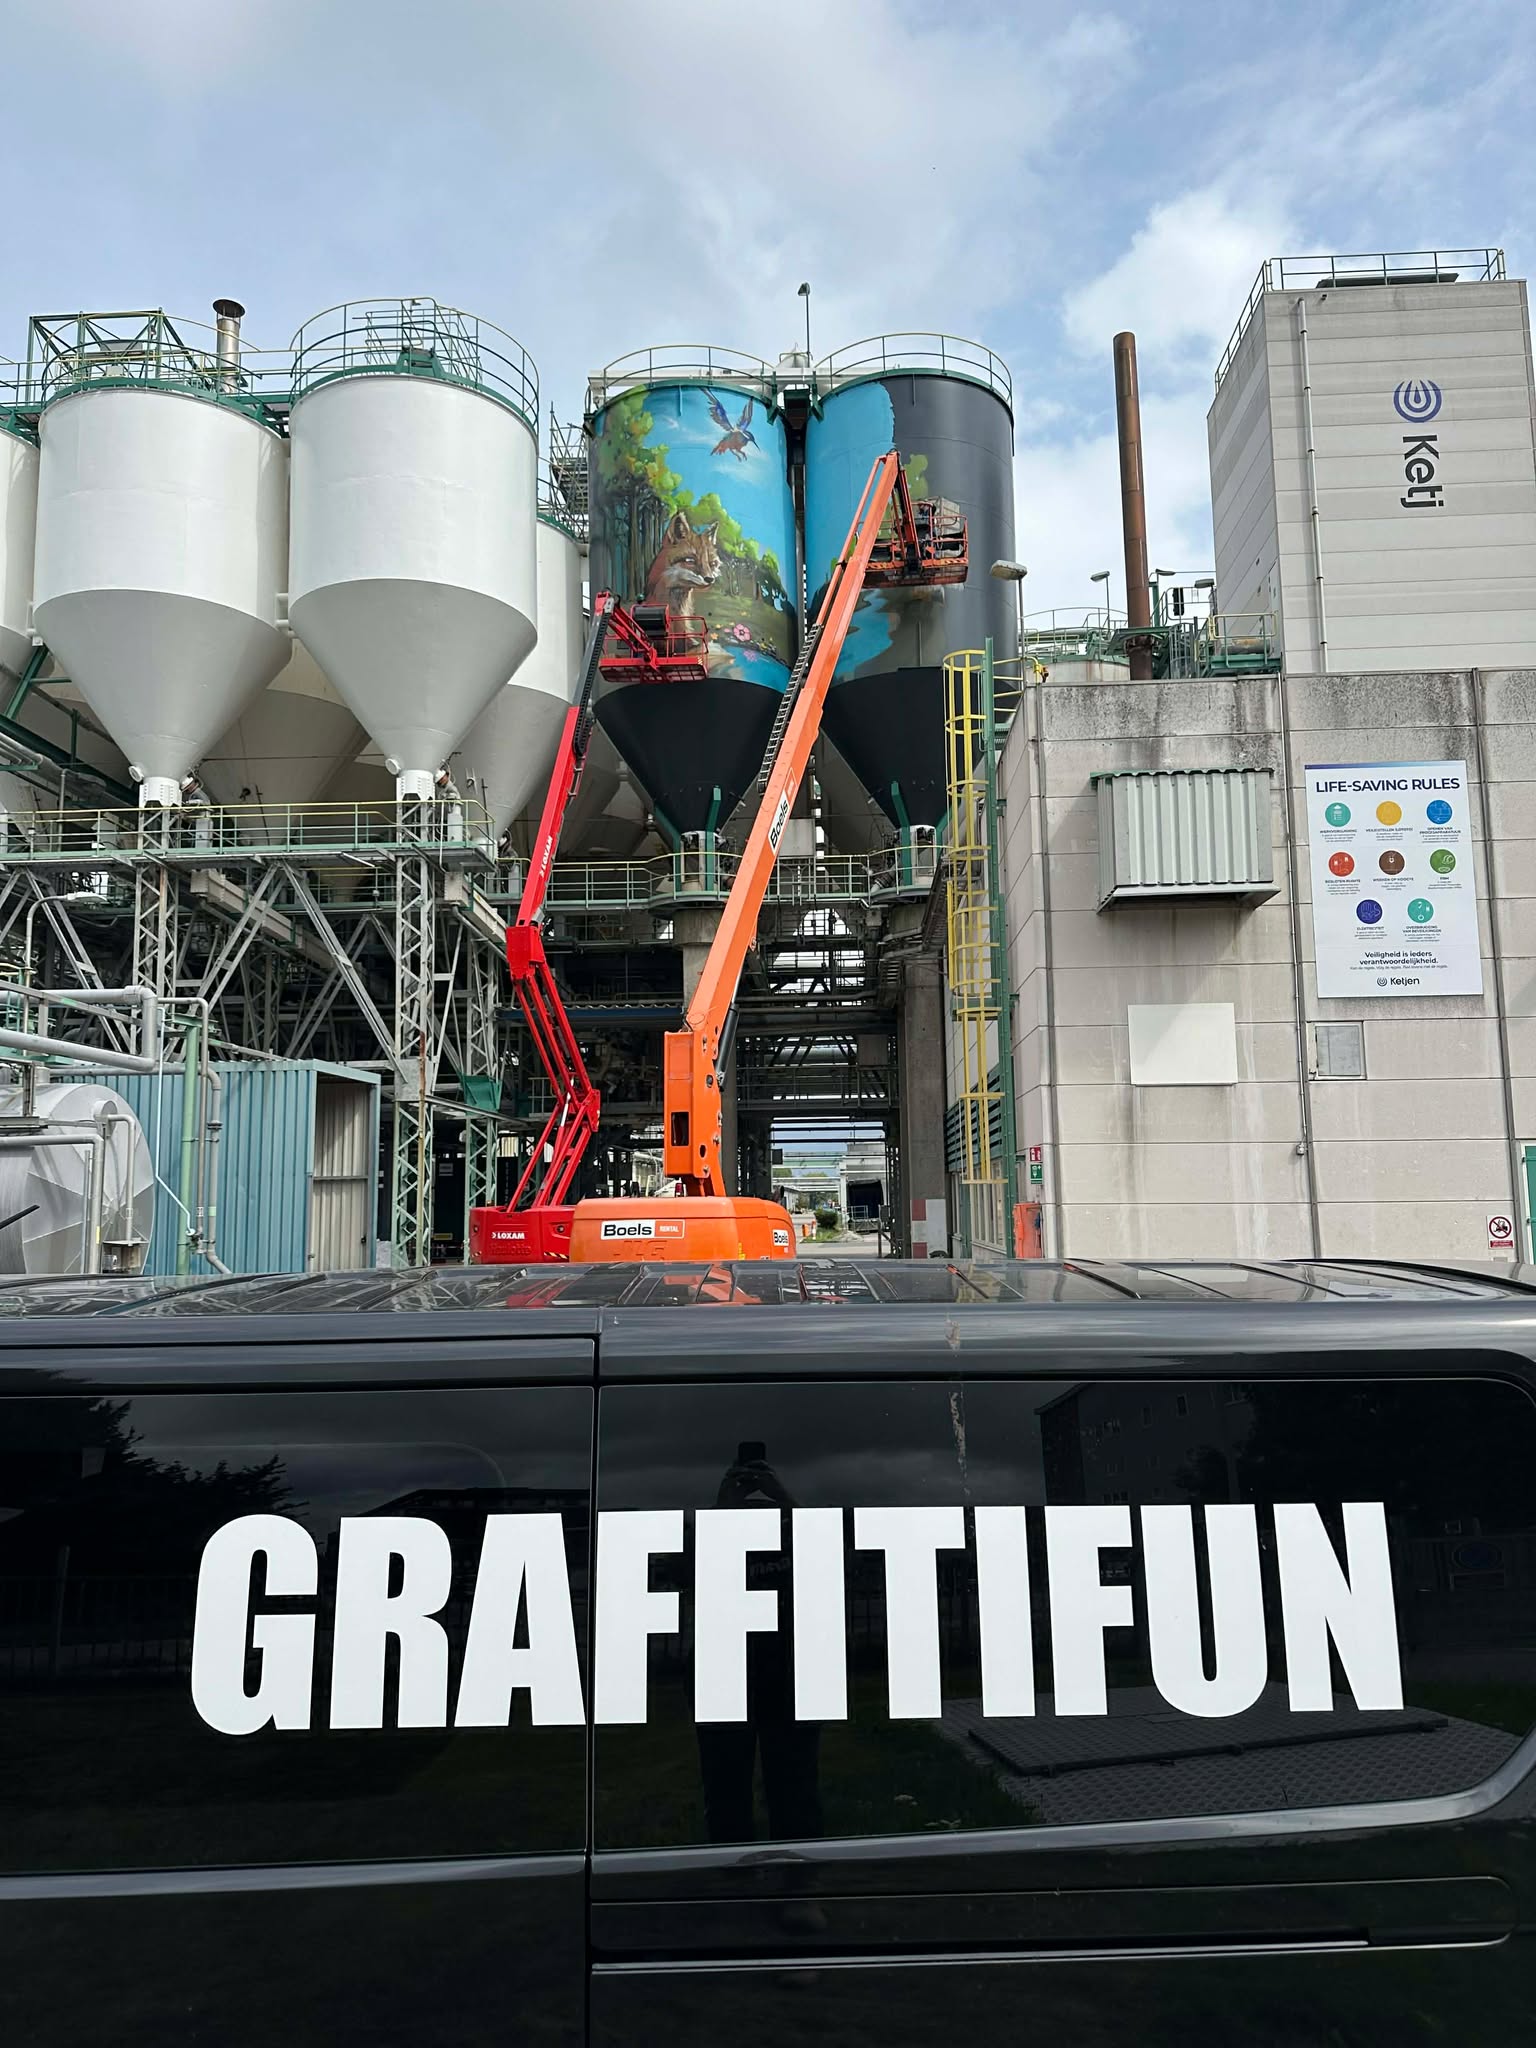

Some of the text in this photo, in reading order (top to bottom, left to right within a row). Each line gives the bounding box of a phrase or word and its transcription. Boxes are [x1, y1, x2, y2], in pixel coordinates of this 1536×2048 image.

[1400, 435, 1444, 508] Ketj
[1316, 778, 1460, 793] LIFE-SAVING RULES
[770, 800, 789, 850] Boels
[1390, 977, 1420, 986] Ketjen
[604, 1223, 652, 1237] Boels
[191, 1502, 1406, 1736] GRAFFITIFUN
